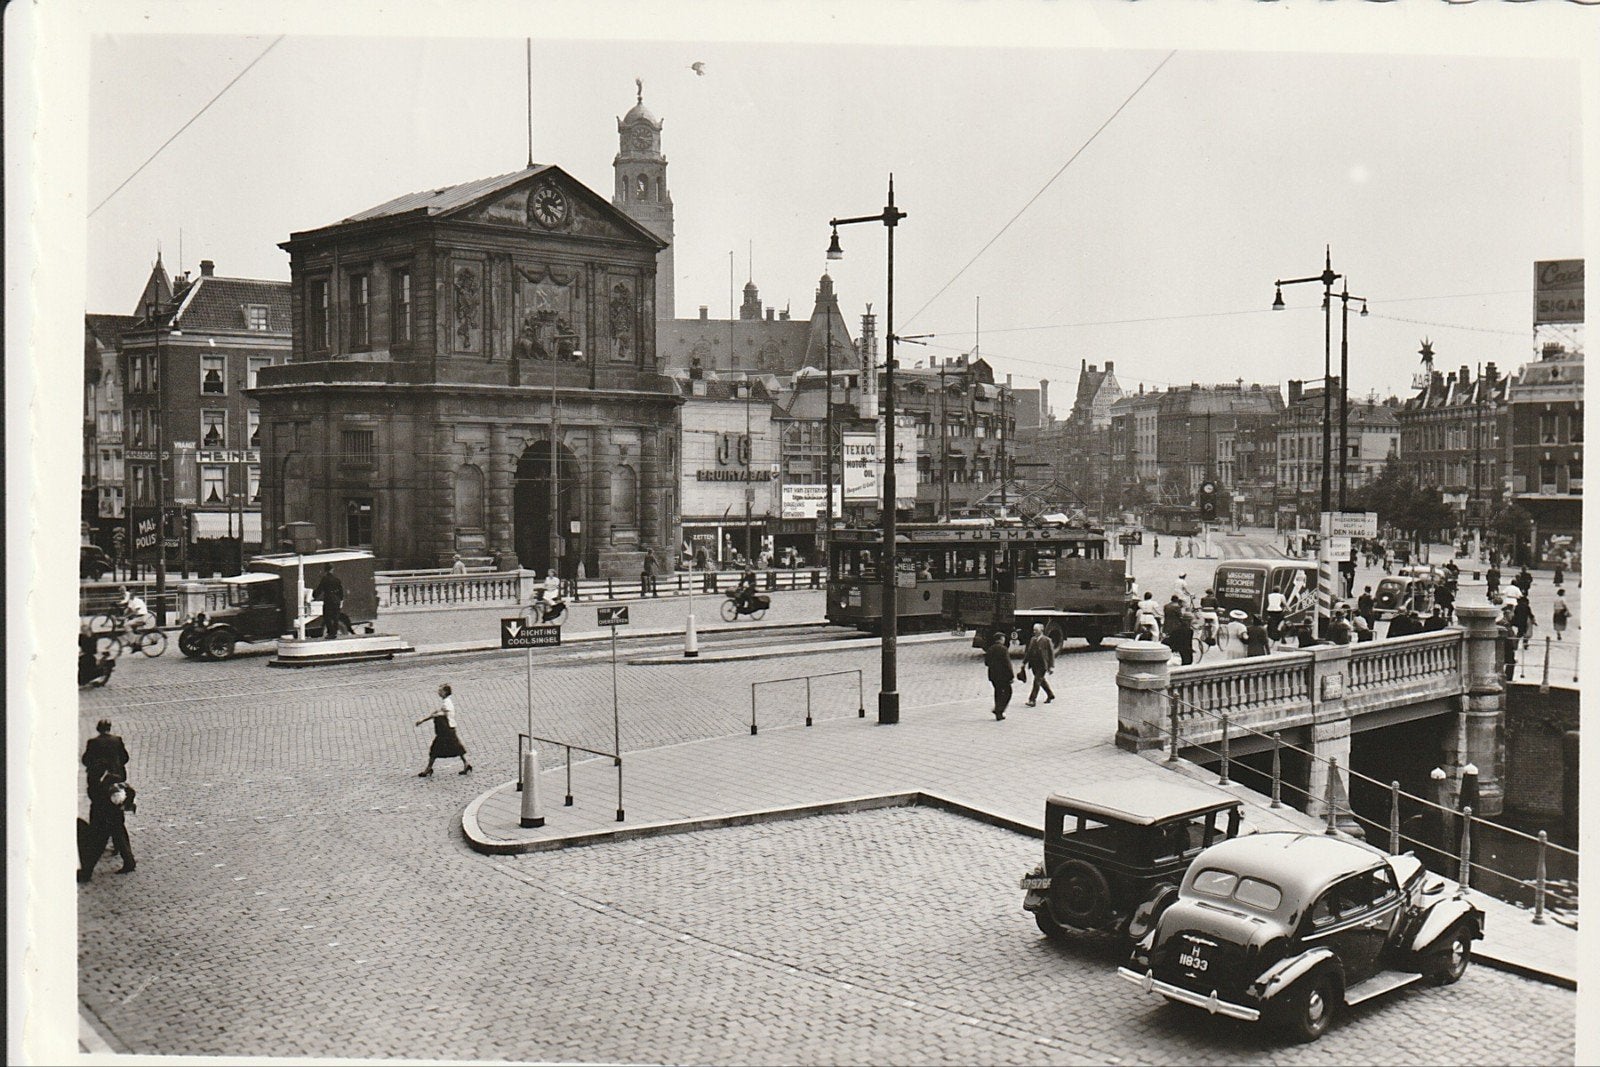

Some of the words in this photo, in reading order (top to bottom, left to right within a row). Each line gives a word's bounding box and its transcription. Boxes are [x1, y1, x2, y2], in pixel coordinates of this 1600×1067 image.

[846, 445, 875, 455] TEXACO
[520, 629, 558, 637] RICHTING
[507, 637, 559, 646] COOLSINGEL
[1192, 945, 1201, 956] H
[1179, 954, 1209, 971] 11833
